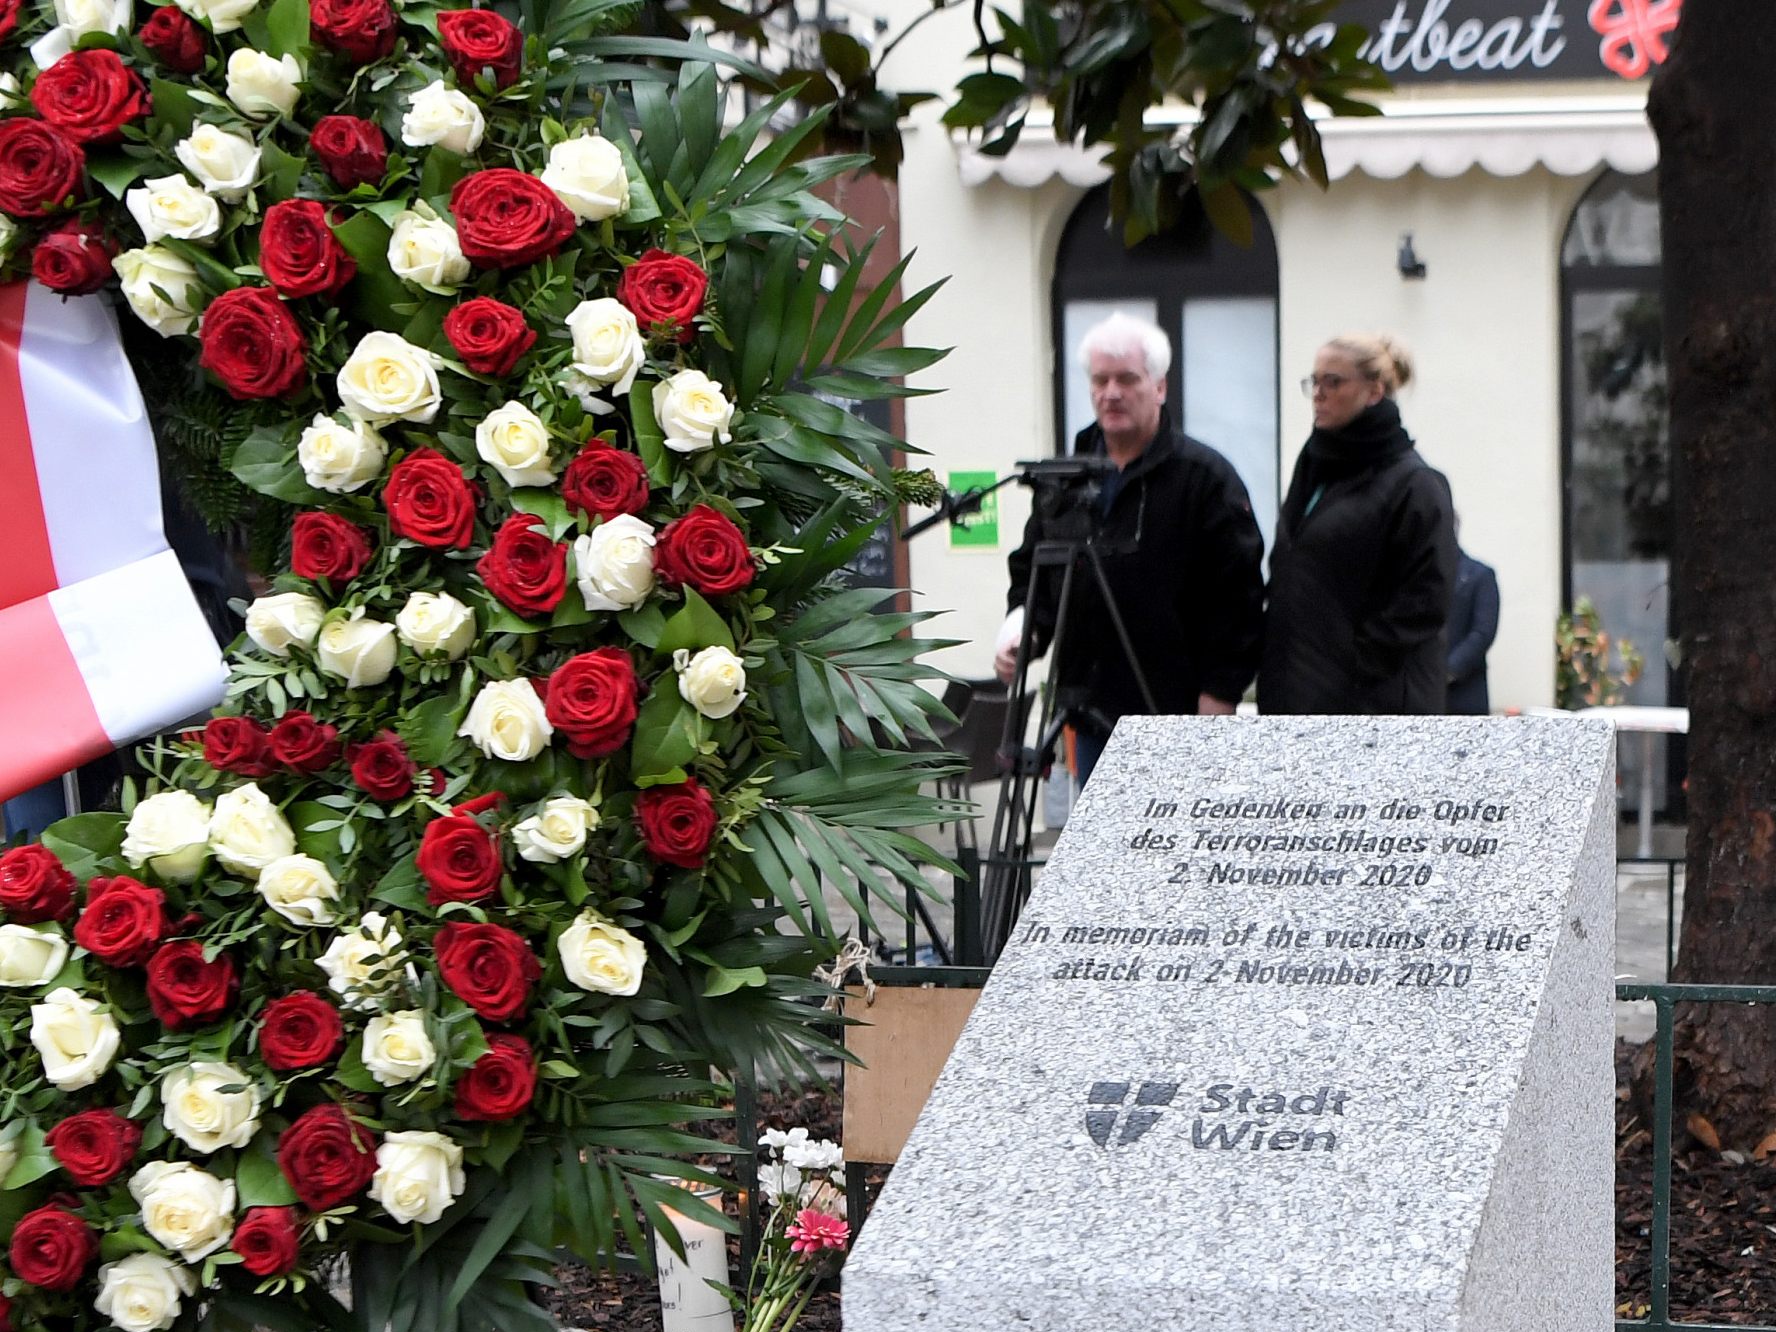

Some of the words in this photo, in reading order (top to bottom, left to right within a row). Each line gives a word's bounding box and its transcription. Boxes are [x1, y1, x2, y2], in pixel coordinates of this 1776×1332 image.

[1143, 799, 1178, 819] Im
[1189, 799, 1326, 820] Gedenken
[1333, 803, 1366, 820] an
[1379, 799, 1420, 821] die
[1433, 800, 1510, 827] Opfer
[1130, 828, 1178, 850] des
[1193, 829, 1429, 858] Terroranschlages
[1441, 835, 1499, 855] vom
[1167, 862, 1192, 886] 2.
[1207, 863, 1351, 887] November
[1359, 864, 1433, 887] 2020
[1021, 922, 1050, 944] In
[1061, 924, 1208, 948] memoriam
[1222, 922, 1257, 947] of
[1265, 924, 1310, 949] the
[1325, 925, 1429, 951] victims
[1441, 927, 1471, 952] of
[1485, 926, 1532, 953] the
[1051, 956, 1142, 982] attack
[1156, 962, 1193, 983] on
[1204, 959, 1222, 984] 2
[1235, 960, 1384, 987] November
[1396, 962, 1472, 989] 2020
[1199, 1084, 1352, 1116] Stadt
[1192, 1118, 1337, 1151] Wien
